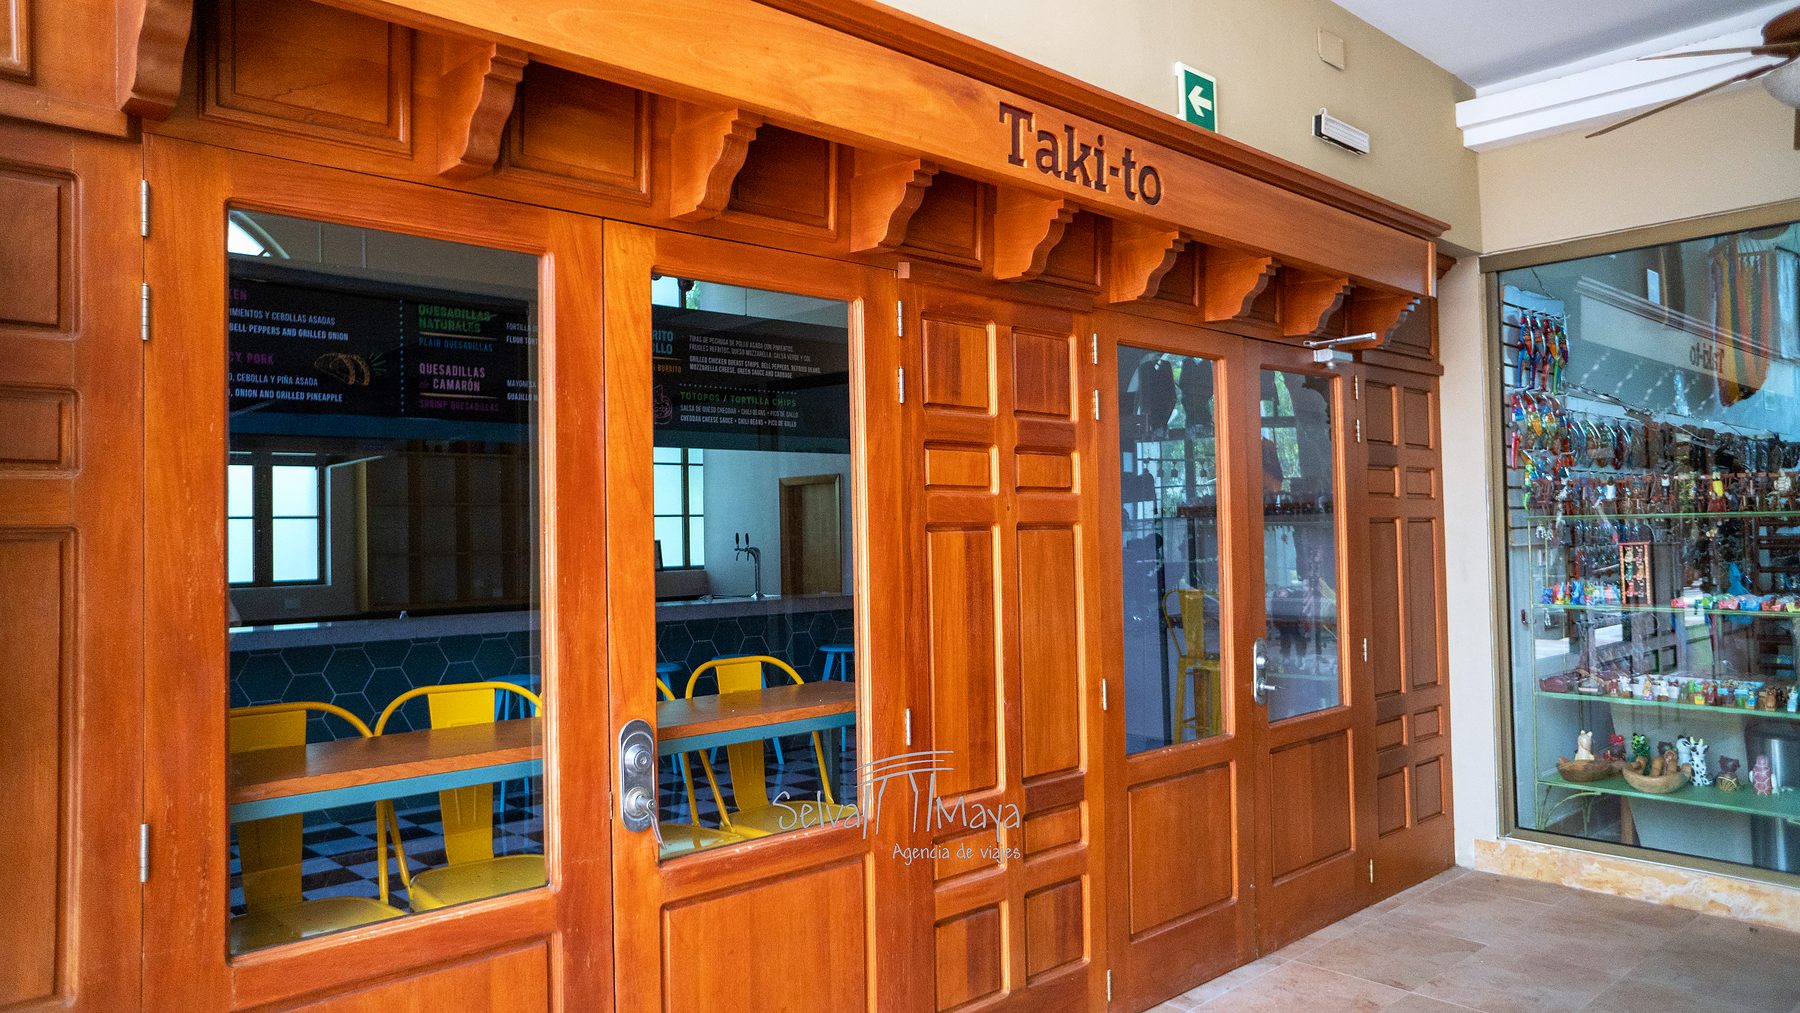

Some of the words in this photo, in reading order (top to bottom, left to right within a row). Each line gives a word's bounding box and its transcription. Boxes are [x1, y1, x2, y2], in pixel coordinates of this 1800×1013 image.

[999, 101, 1163, 205] Taki-to
[265, 310, 270, 320] Y
[272, 311, 306, 323] CEBOLLAS
[308, 315, 336, 326] ASADAS
[418, 304, 491, 321] QUESADILLAS
[248, 324, 280, 336] PEPPERS
[282, 327, 296, 336] AND
[298, 329, 326, 339] GRILLED
[328, 331, 348, 341] ONION
[418, 317, 480, 333] NATURALES
[444, 342, 493, 352] QUESADILLAS
[246, 352, 274, 365] PORK
[419, 362, 486, 378] QUESADILLAS
[236, 373, 268, 384] CEBOLLA
[270, 375, 276, 384] Y
[277, 374, 293, 385] PIÑA
[433, 378, 480, 392] CAMARÓN
[235, 388, 258, 398] ONION
[259, 389, 274, 398] AND
[276, 390, 304, 400] GRILLED
[306, 392, 342, 402] PINEAPPLE
[680, 392, 720, 402] TOTOPOS
[731, 395, 769, 406] TORTILLA
[772, 398, 796, 407] CHIPS
